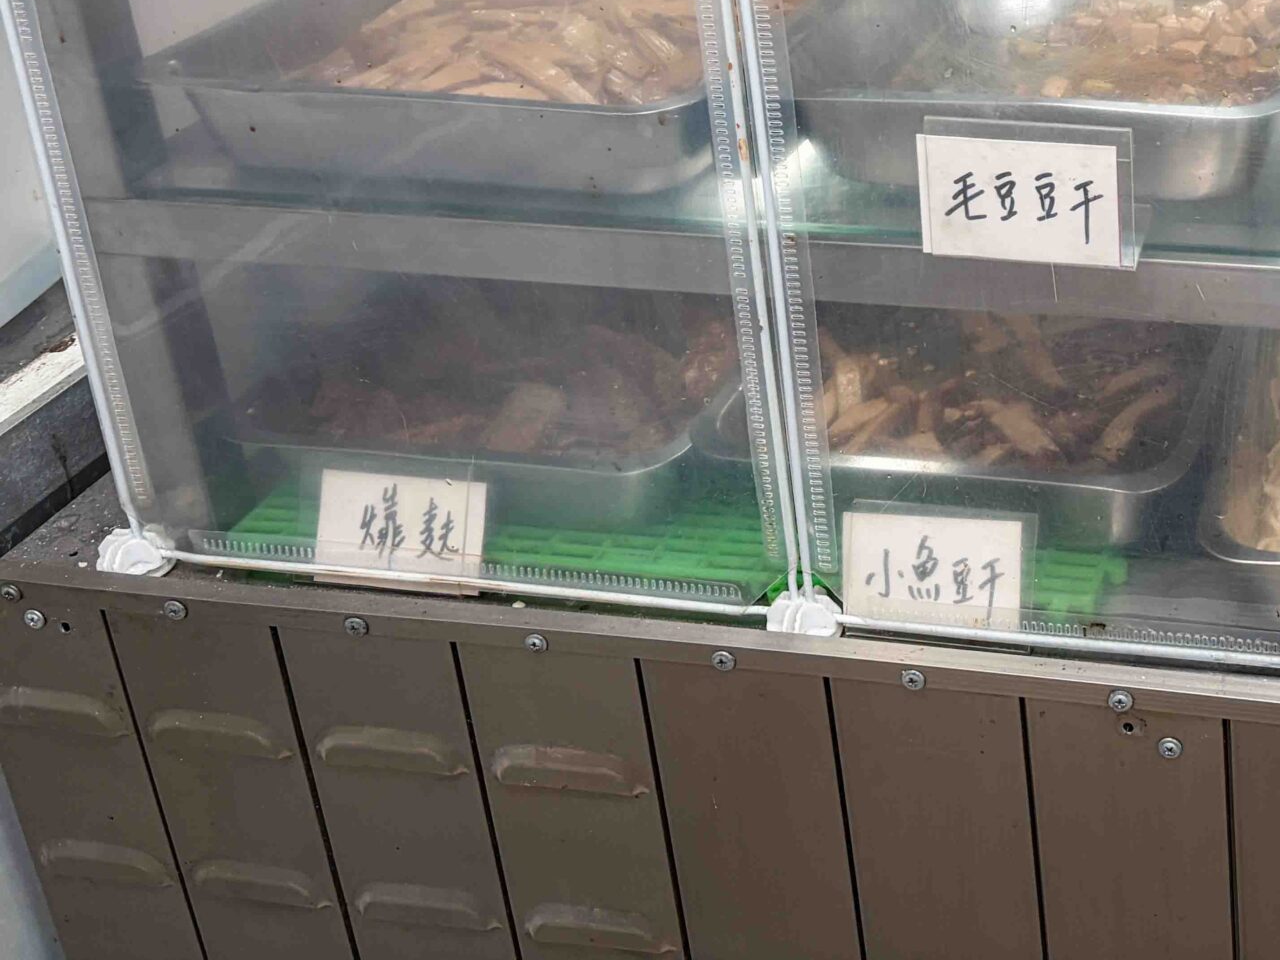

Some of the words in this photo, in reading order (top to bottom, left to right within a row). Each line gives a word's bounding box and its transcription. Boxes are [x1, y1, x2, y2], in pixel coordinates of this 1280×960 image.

[945, 171, 1104, 244] 毛豆豆干
[865, 535, 1005, 621] 小魚豆干
